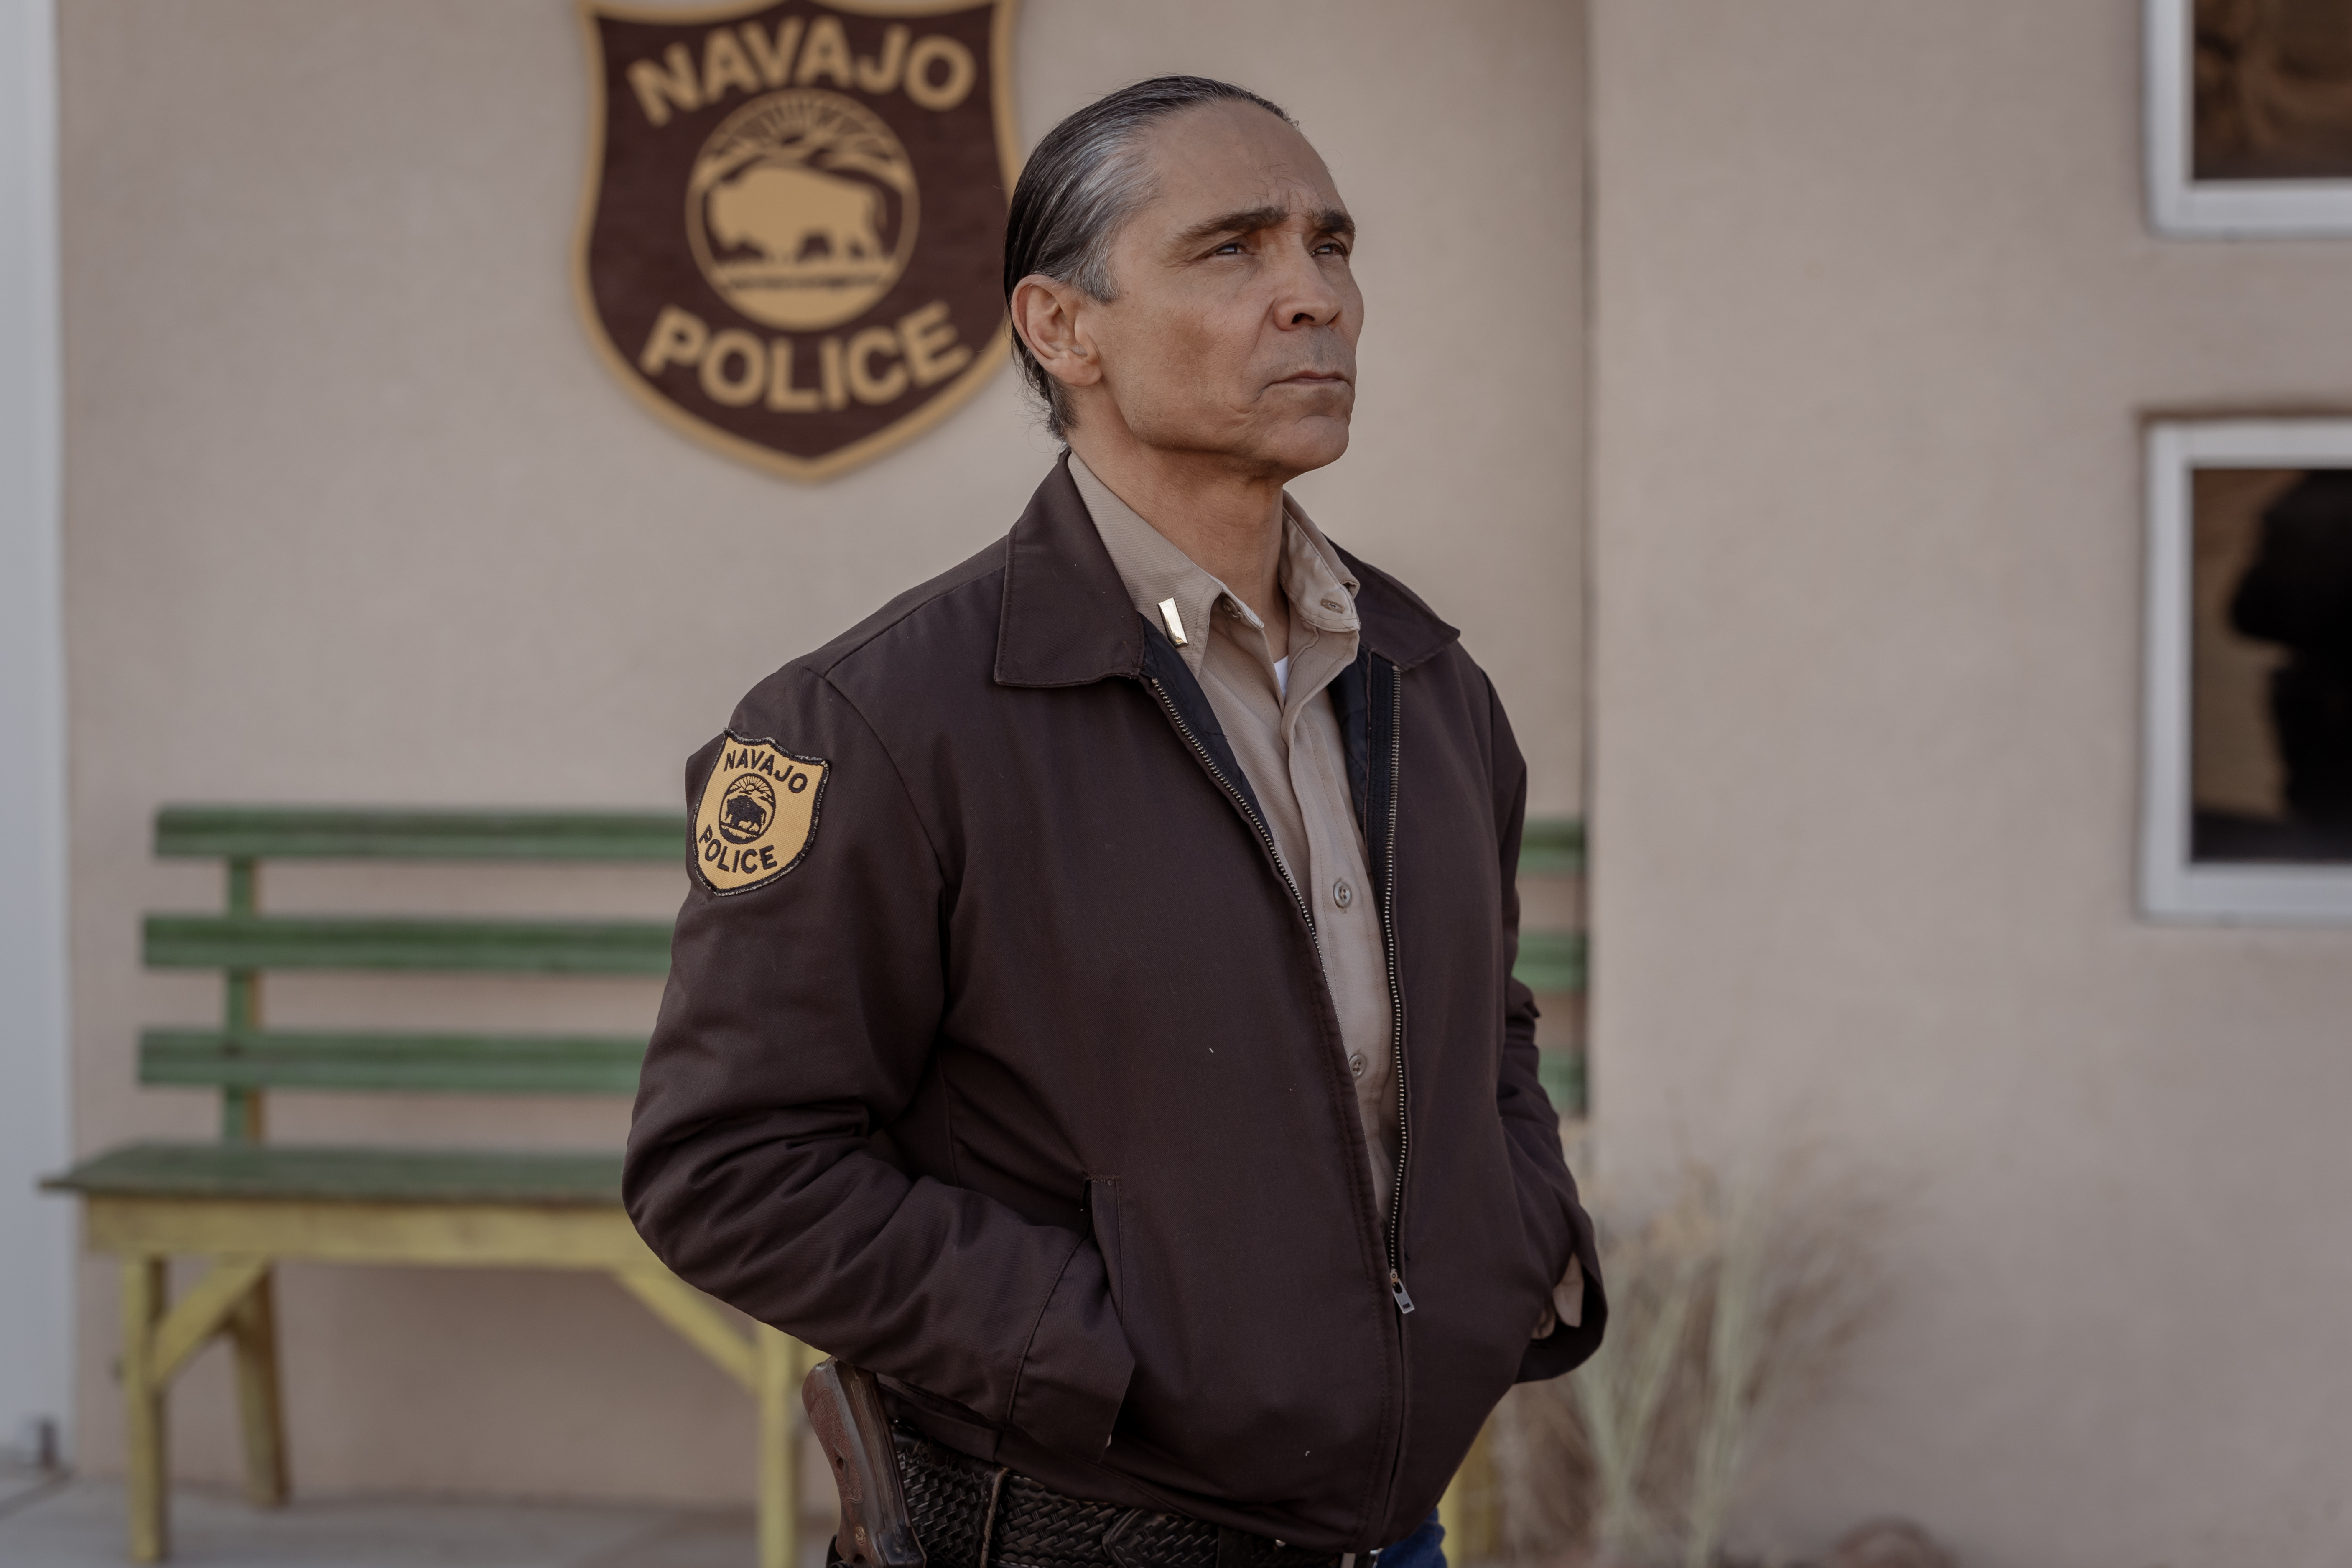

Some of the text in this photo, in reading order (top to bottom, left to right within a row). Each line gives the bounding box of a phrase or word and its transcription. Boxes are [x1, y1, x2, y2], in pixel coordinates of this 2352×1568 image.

[627, 16, 976, 126] NAVAJO
[641, 302, 970, 412] POLICE
[724, 749, 808, 793] NAVAJO
[698, 824, 777, 873] POLICE
